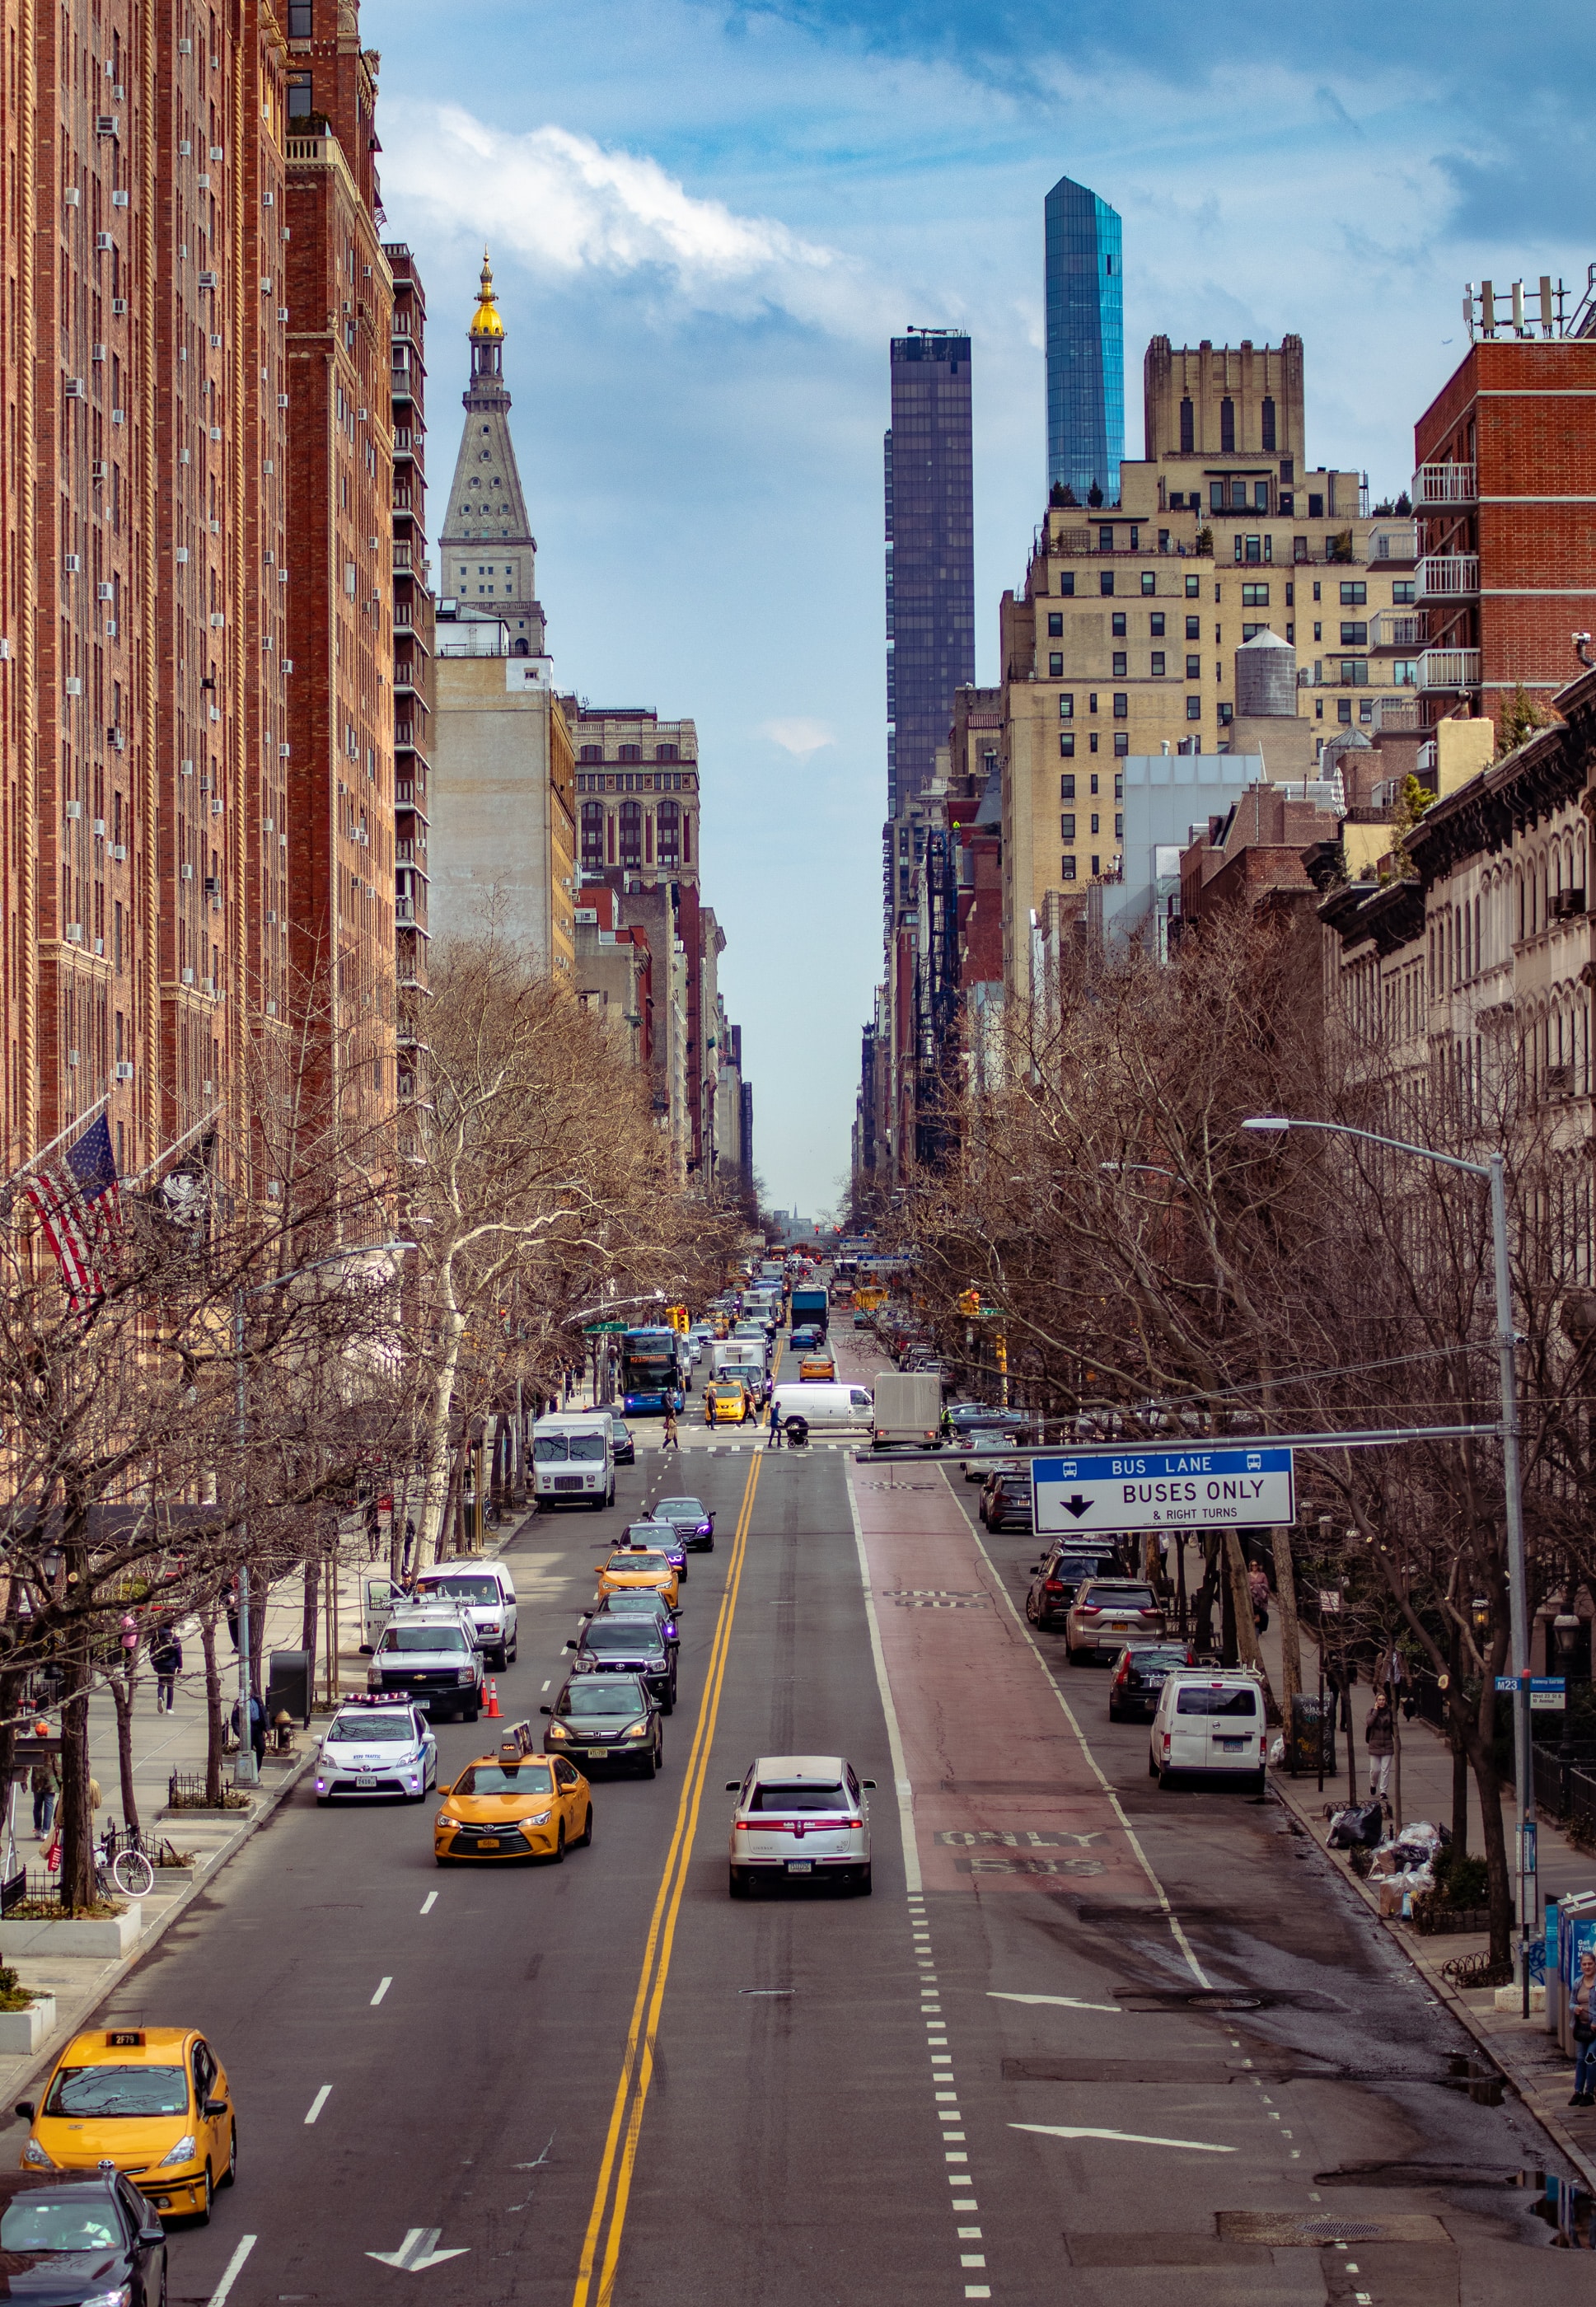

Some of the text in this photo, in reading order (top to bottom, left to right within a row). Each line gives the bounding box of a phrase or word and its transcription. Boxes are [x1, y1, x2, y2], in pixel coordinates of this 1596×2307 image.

[1112, 1457, 1212, 1475] BUS LANE
[1123, 1479, 1265, 1504] BUSES ONLY
[1153, 1507, 1238, 1520] & RIGHT TURNS
[1497, 1679, 1518, 1690] M23
[940, 1831, 1103, 1846] ONLY
[971, 1858, 1103, 1875] BUS
[115, 2035, 134, 2044] 2F79
